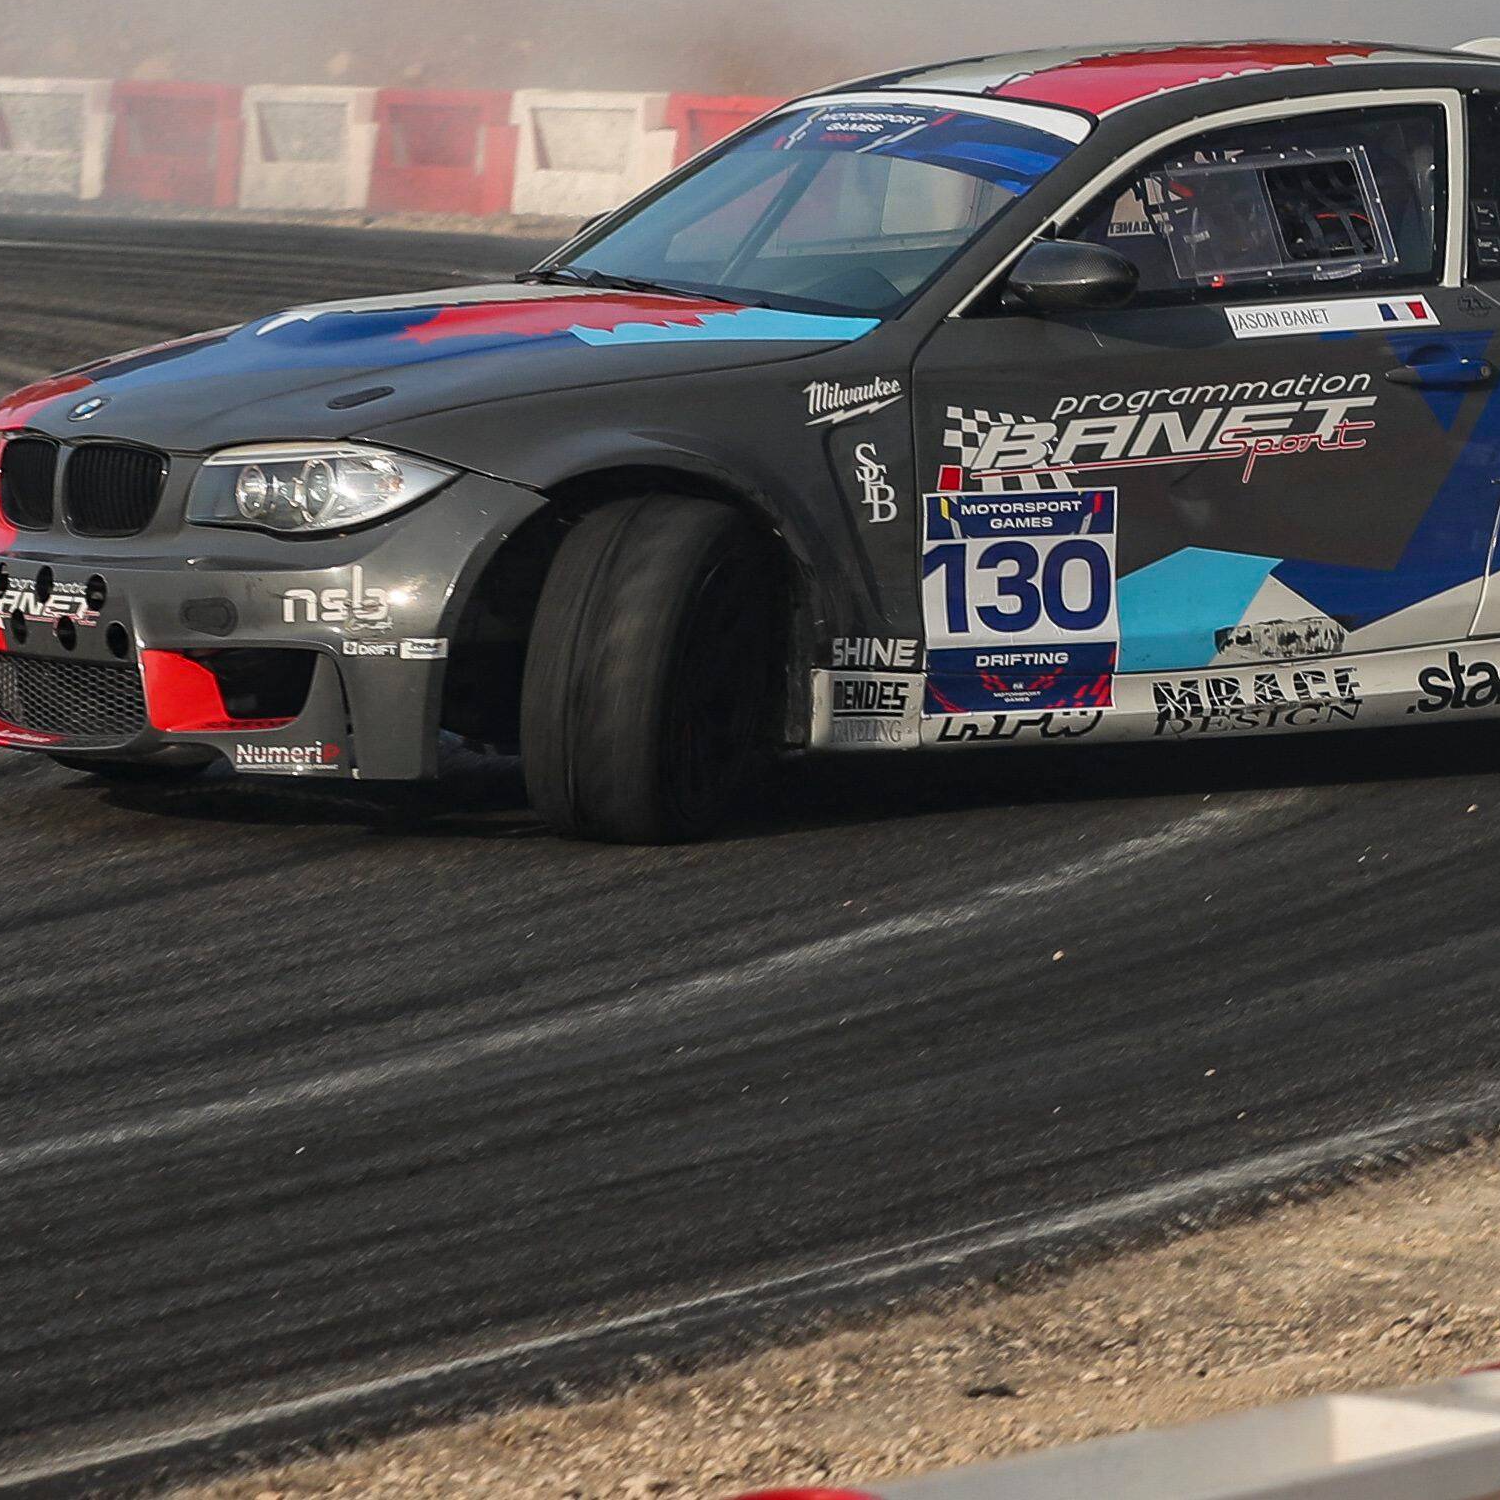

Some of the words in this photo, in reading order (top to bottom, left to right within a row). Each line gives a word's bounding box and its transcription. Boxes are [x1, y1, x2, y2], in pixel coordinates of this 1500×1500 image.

[1232, 311, 1280, 331] JASON
[1284, 308, 1329, 328] BANET
[802, 376, 902, 414] Milwaukee
[1052, 372, 1370, 421] programmation
[971, 396, 1377, 469] BANET
[1219, 419, 1376, 484] Sport
[961, 501, 1082, 515] MOTORSPORT
[990, 517, 1053, 529] GAMES
[922, 539, 1111, 633] 130
[832, 637, 918, 667] SHINE
[975, 652, 1069, 668] DRIFTING
[1154, 697, 1363, 738] DESIGN
